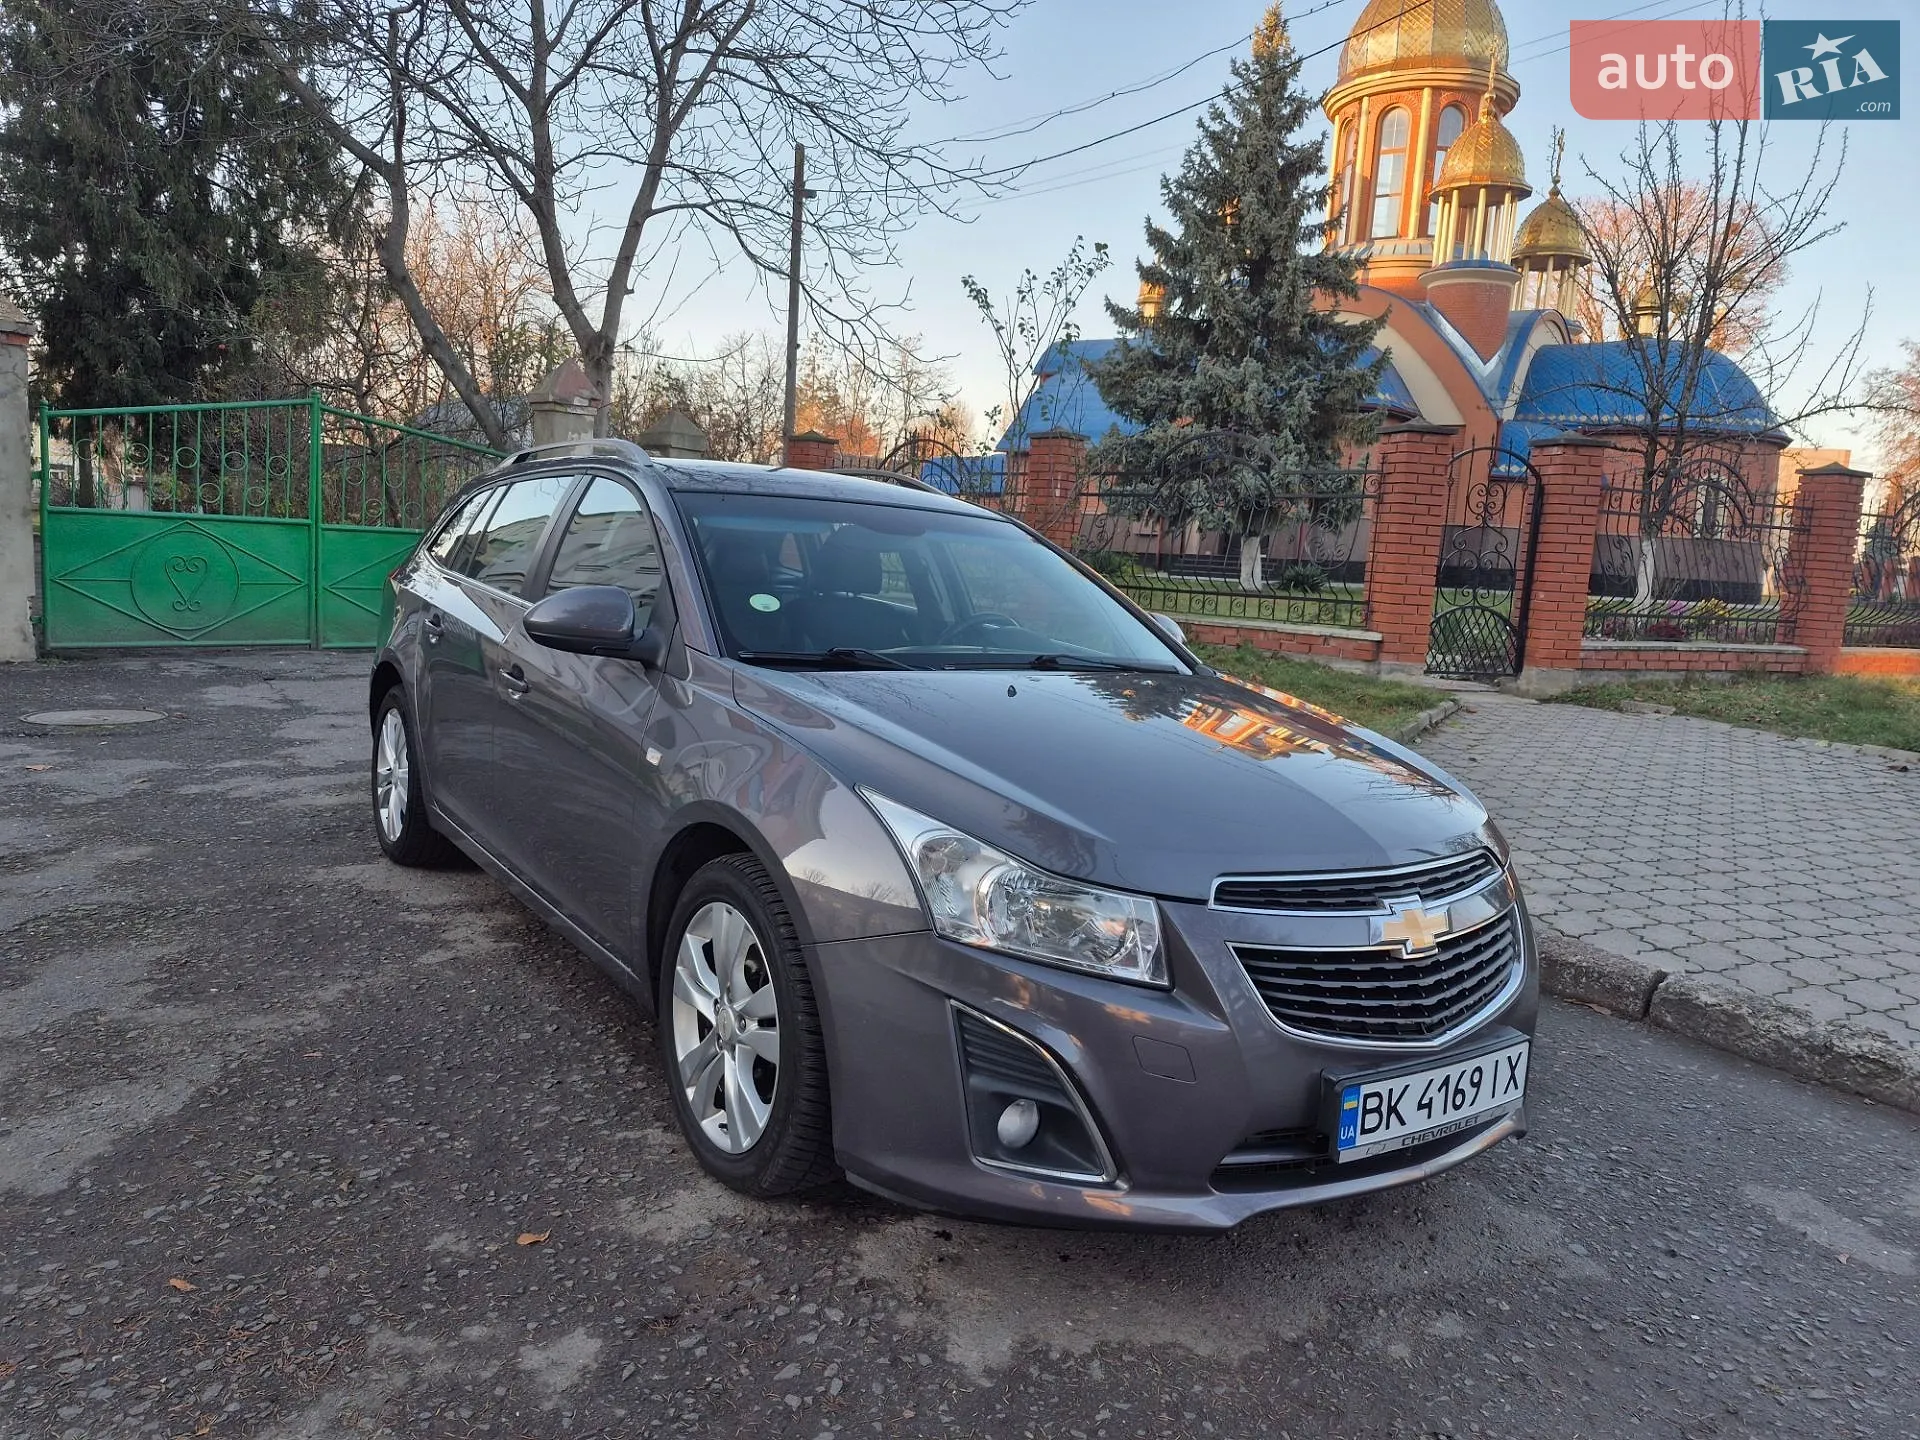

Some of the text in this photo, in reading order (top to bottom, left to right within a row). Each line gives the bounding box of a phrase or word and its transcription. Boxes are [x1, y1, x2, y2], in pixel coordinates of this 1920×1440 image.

[1359, 1052, 1523, 1136] BK 4169 IX
[1340, 1124, 1355, 1140] UA
[1401, 1115, 1481, 1147] CHEVROLET
